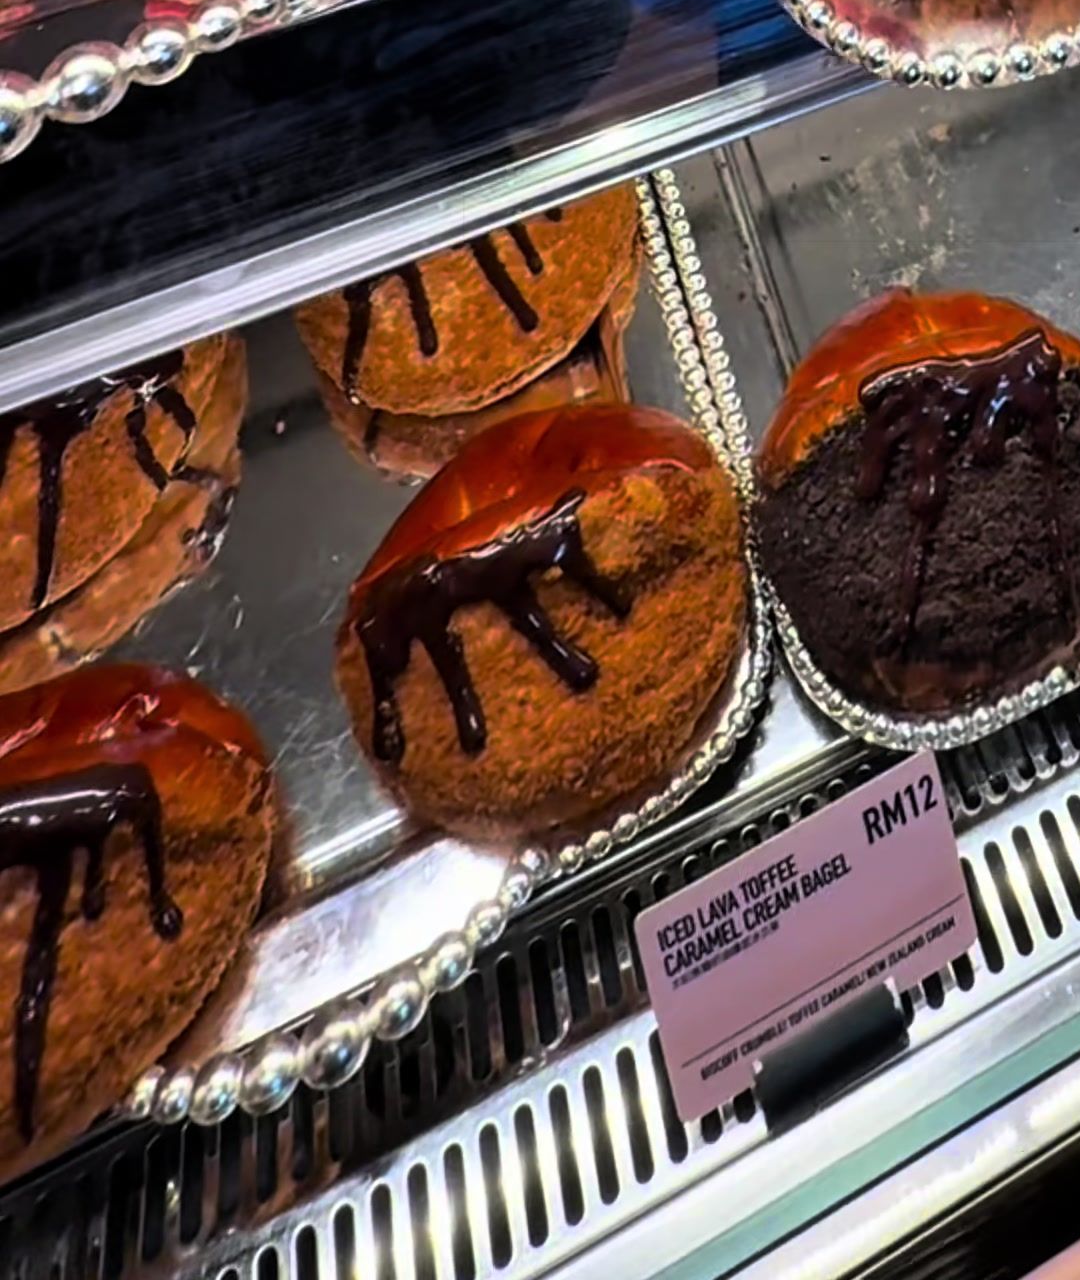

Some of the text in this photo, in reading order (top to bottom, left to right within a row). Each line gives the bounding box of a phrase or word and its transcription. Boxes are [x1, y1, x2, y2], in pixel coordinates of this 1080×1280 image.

[863, 774, 938, 844] RM12
[657, 853, 797, 952] ICED LAVA TOFFEE
[663, 918, 742, 977] CARAMEL
[743, 882, 800, 930] CREAM
[800, 853, 852, 898] BAGEL
[867, 959, 886, 980] NEW
[925, 916, 956, 944] CREAM
